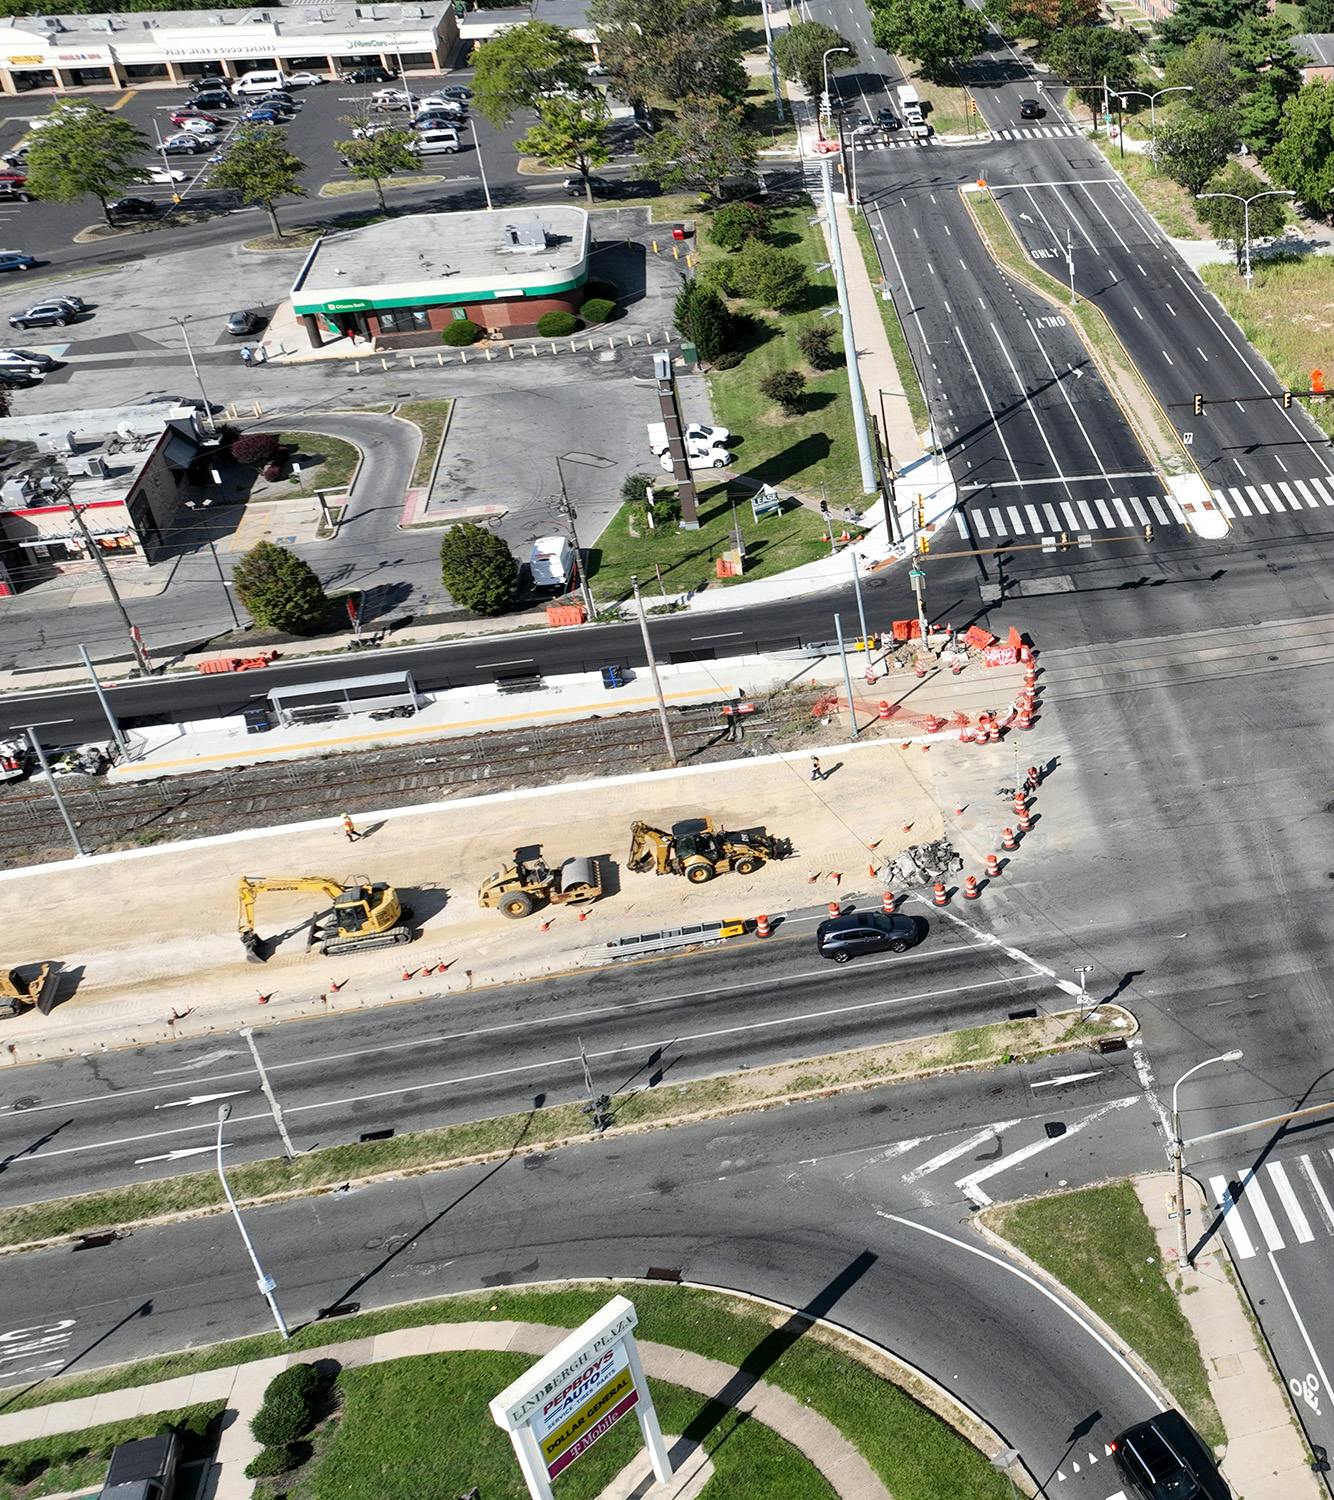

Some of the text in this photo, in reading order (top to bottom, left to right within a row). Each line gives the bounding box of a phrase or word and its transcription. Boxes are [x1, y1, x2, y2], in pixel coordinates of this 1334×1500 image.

[1031, 248, 1059, 259] ONLY
[1036, 316, 1066, 329] ONLY
[753, 493, 778, 506] LEASE
[512, 1314, 635, 1423] LINDBERGH PLAZA
[542, 1349, 615, 1416] PEPBOYS
[561, 1371, 602, 1410] AUTO
[546, 1379, 630, 1454] DOLLAR GENERAL
[547, 1405, 577, 1432] SERVICE
[596, 1368, 617, 1387] PARTS
